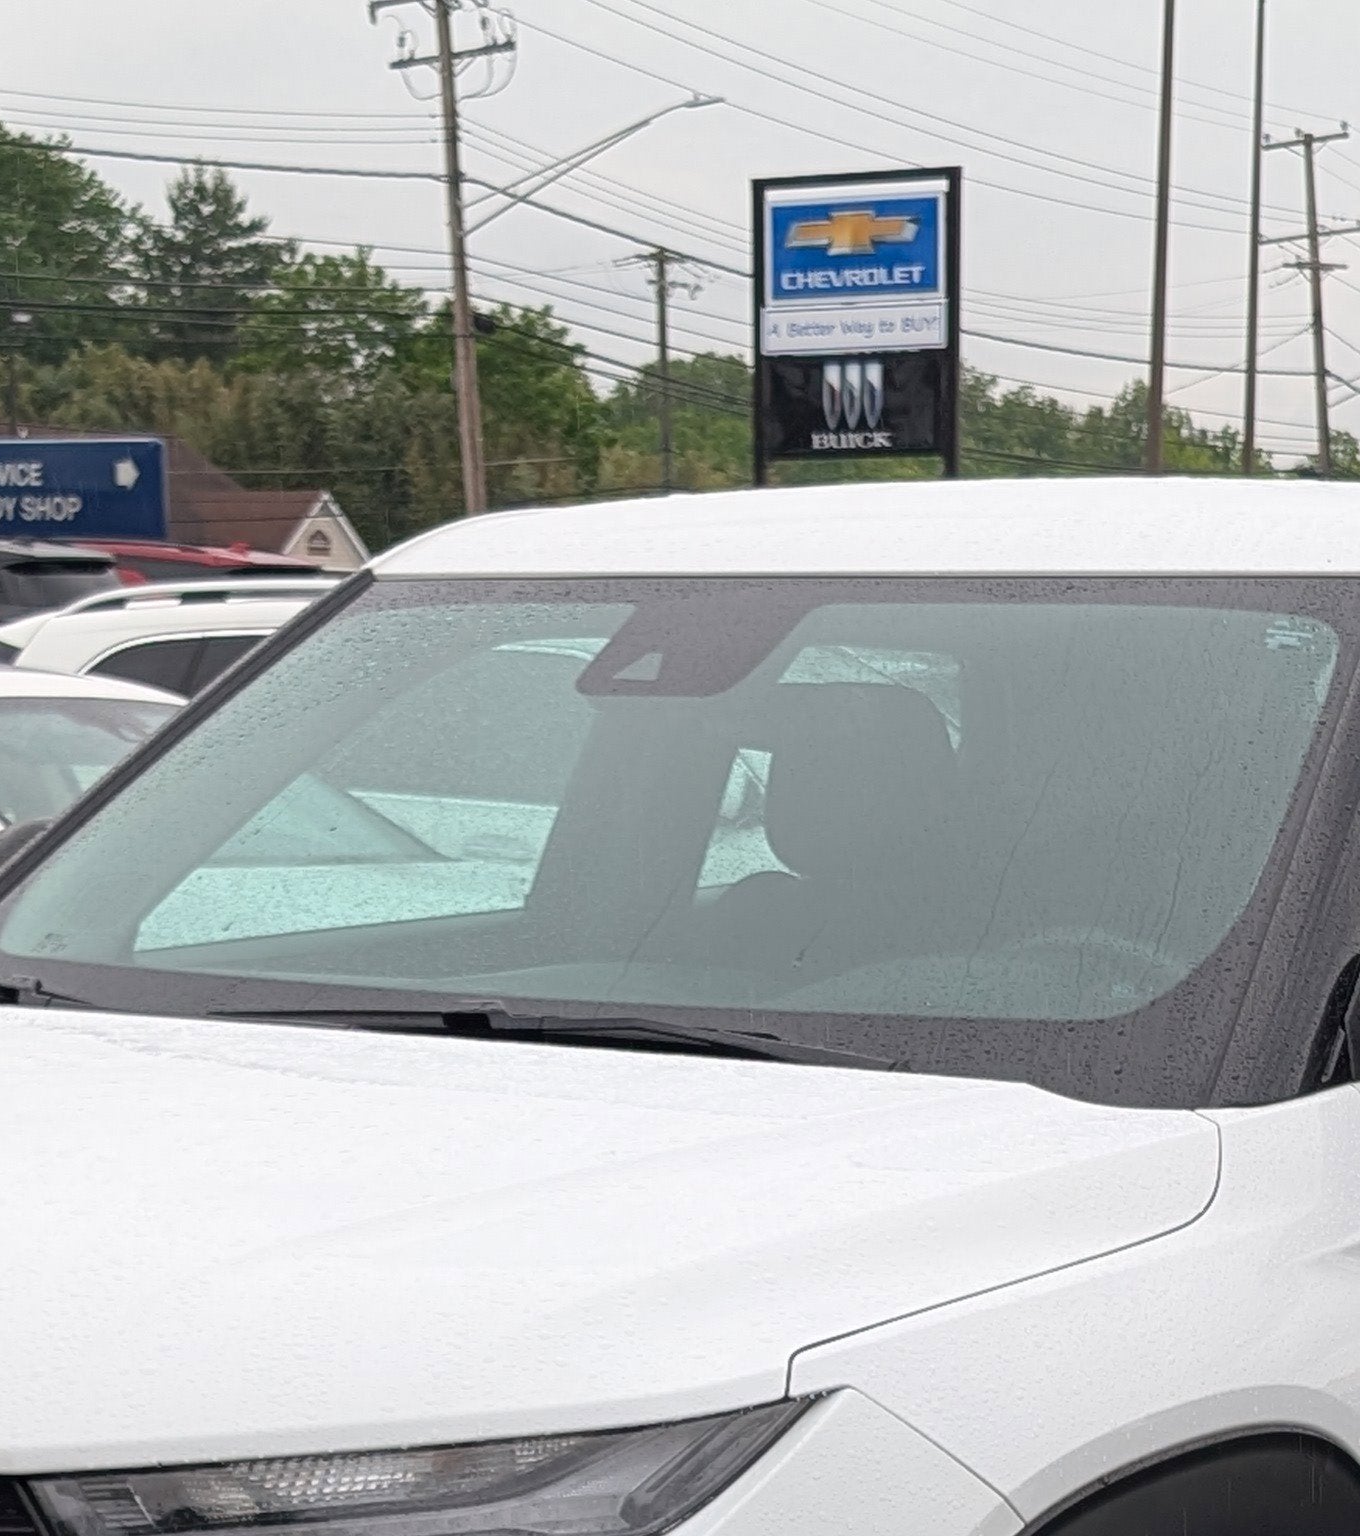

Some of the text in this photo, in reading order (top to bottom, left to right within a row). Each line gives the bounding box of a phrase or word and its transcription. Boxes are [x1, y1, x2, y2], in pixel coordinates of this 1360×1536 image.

[780, 264, 926, 291] CHEVROLET
[811, 431, 892, 450] BUICK
[19, 494, 84, 522] SHOP
